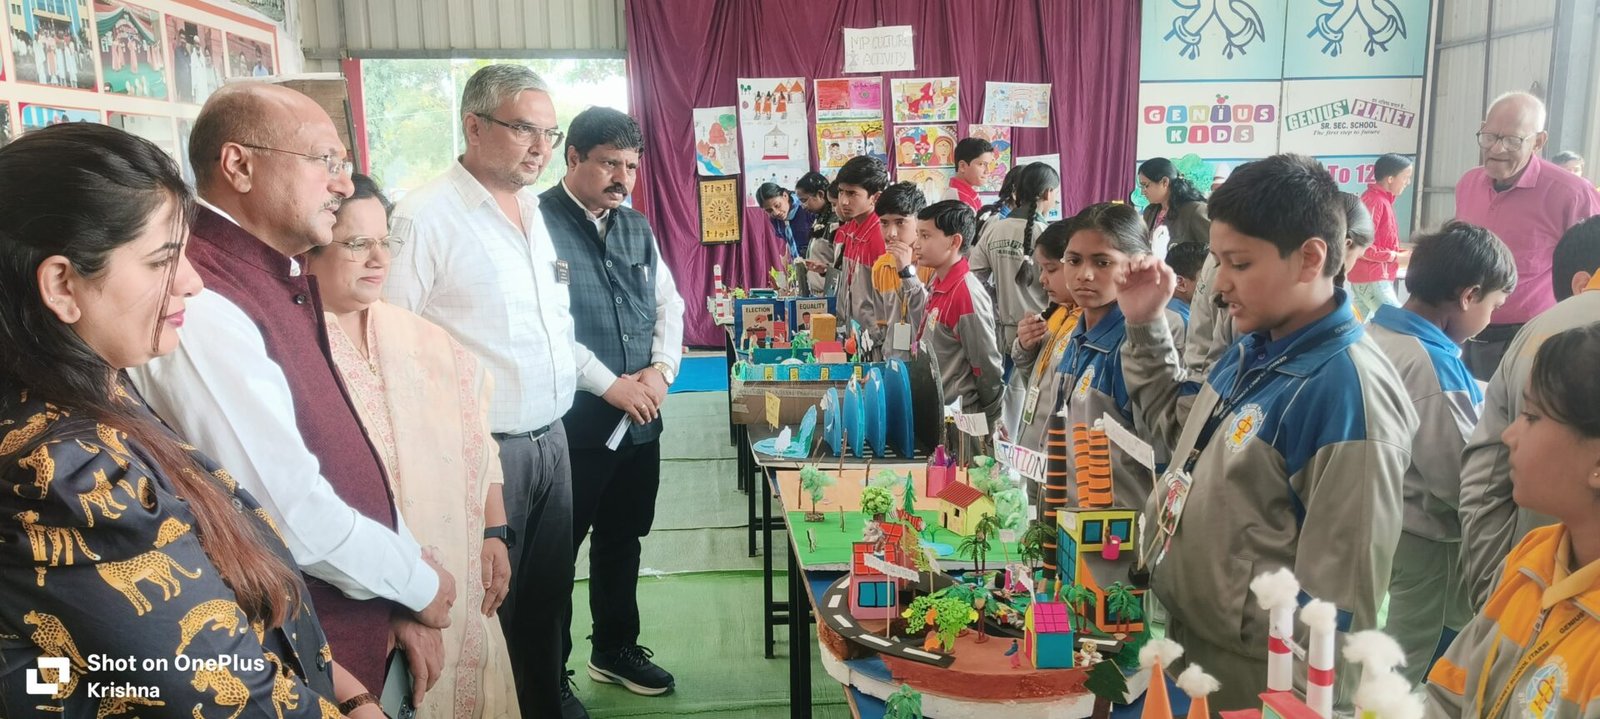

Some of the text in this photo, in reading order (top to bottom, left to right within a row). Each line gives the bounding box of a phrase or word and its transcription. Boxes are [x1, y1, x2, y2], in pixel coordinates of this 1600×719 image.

[1148, 104, 1269, 122] GENIUS
[1352, 100, 1414, 128] PLANET
[1320, 121, 1378, 130] SR. SEC. SCHOOL
[1170, 129, 1250, 142] KIDS
[1328, 165, 1351, 184] To
[1528, 641, 1550, 661] ITARSI
